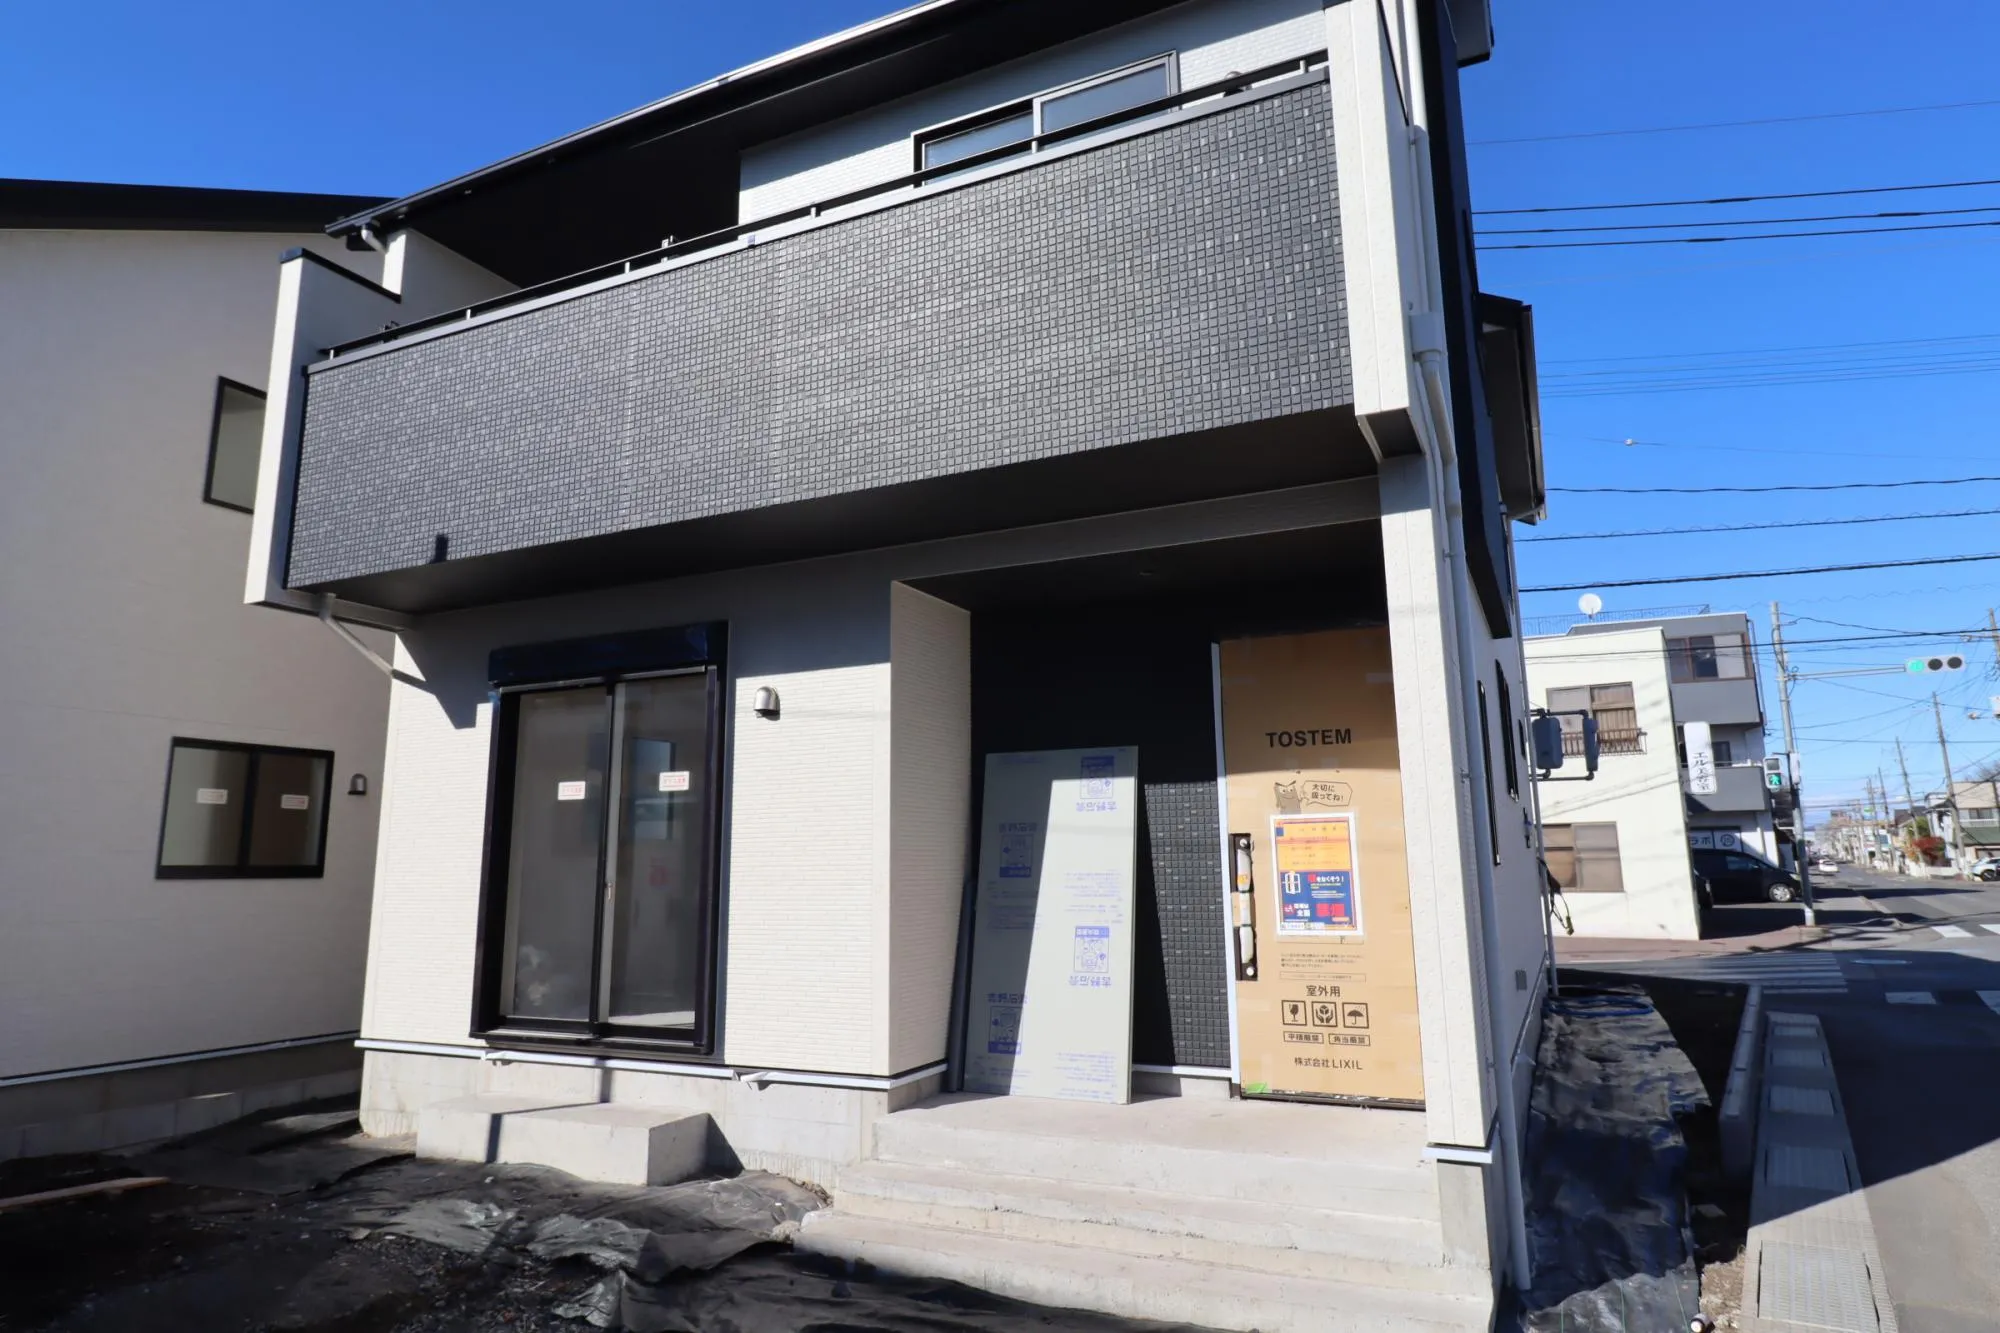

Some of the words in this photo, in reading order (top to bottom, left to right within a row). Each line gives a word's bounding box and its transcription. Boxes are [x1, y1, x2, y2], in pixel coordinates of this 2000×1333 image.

[1265, 728, 1352, 748] TOSTEM
[1312, 783, 1335, 793] 大切に
[1305, 984, 1341, 998] 室外用
